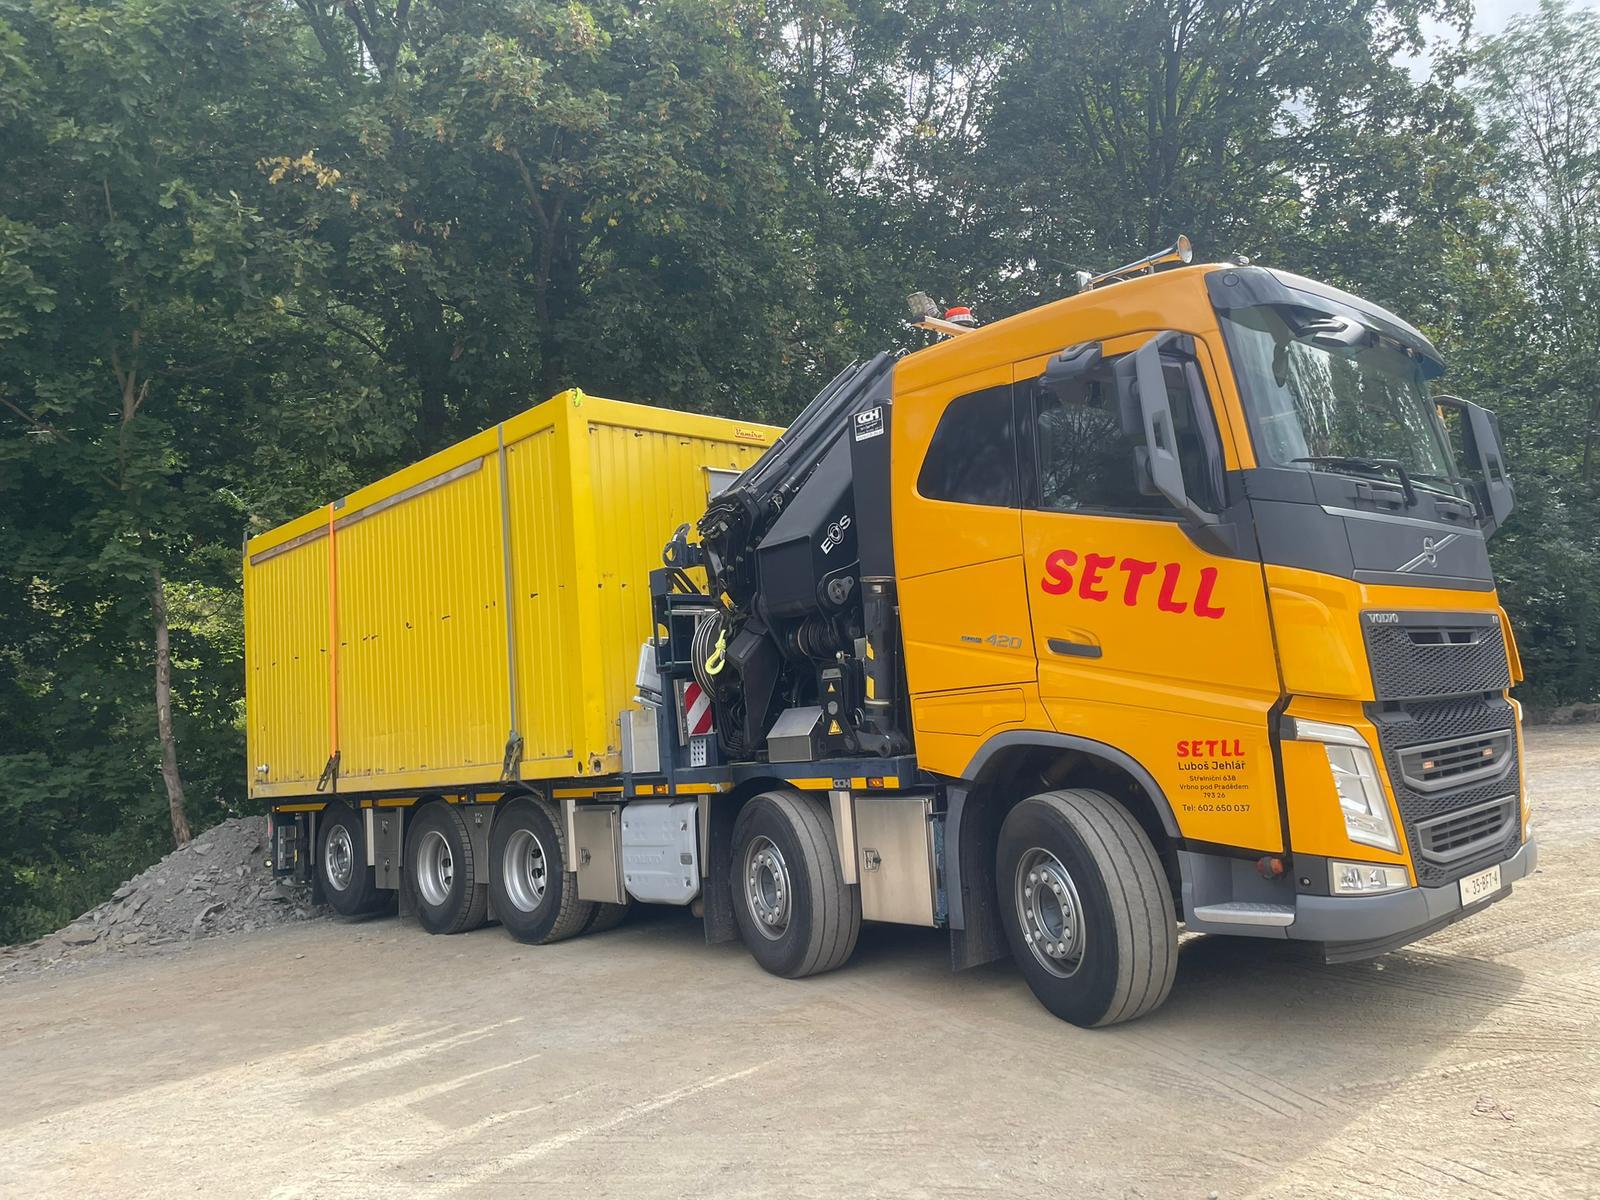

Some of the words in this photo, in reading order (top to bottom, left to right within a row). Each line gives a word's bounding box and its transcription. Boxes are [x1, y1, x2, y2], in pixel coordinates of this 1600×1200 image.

[820, 515, 851, 555] EOS
[1041, 549, 1226, 619] SETLL
[1366, 613, 1399, 623] VOLVO
[986, 634, 1022, 649] 420
[1176, 739, 1245, 757] SETLL
[1178, 761, 1209, 771] Luboš
[1211, 760, 1245, 770] Jehlář
[1182, 804, 1196, 812] Tel:
[1198, 804, 1214, 812] 602
[1216, 804, 1232, 812] 650
[1234, 804, 1250, 812] 037
